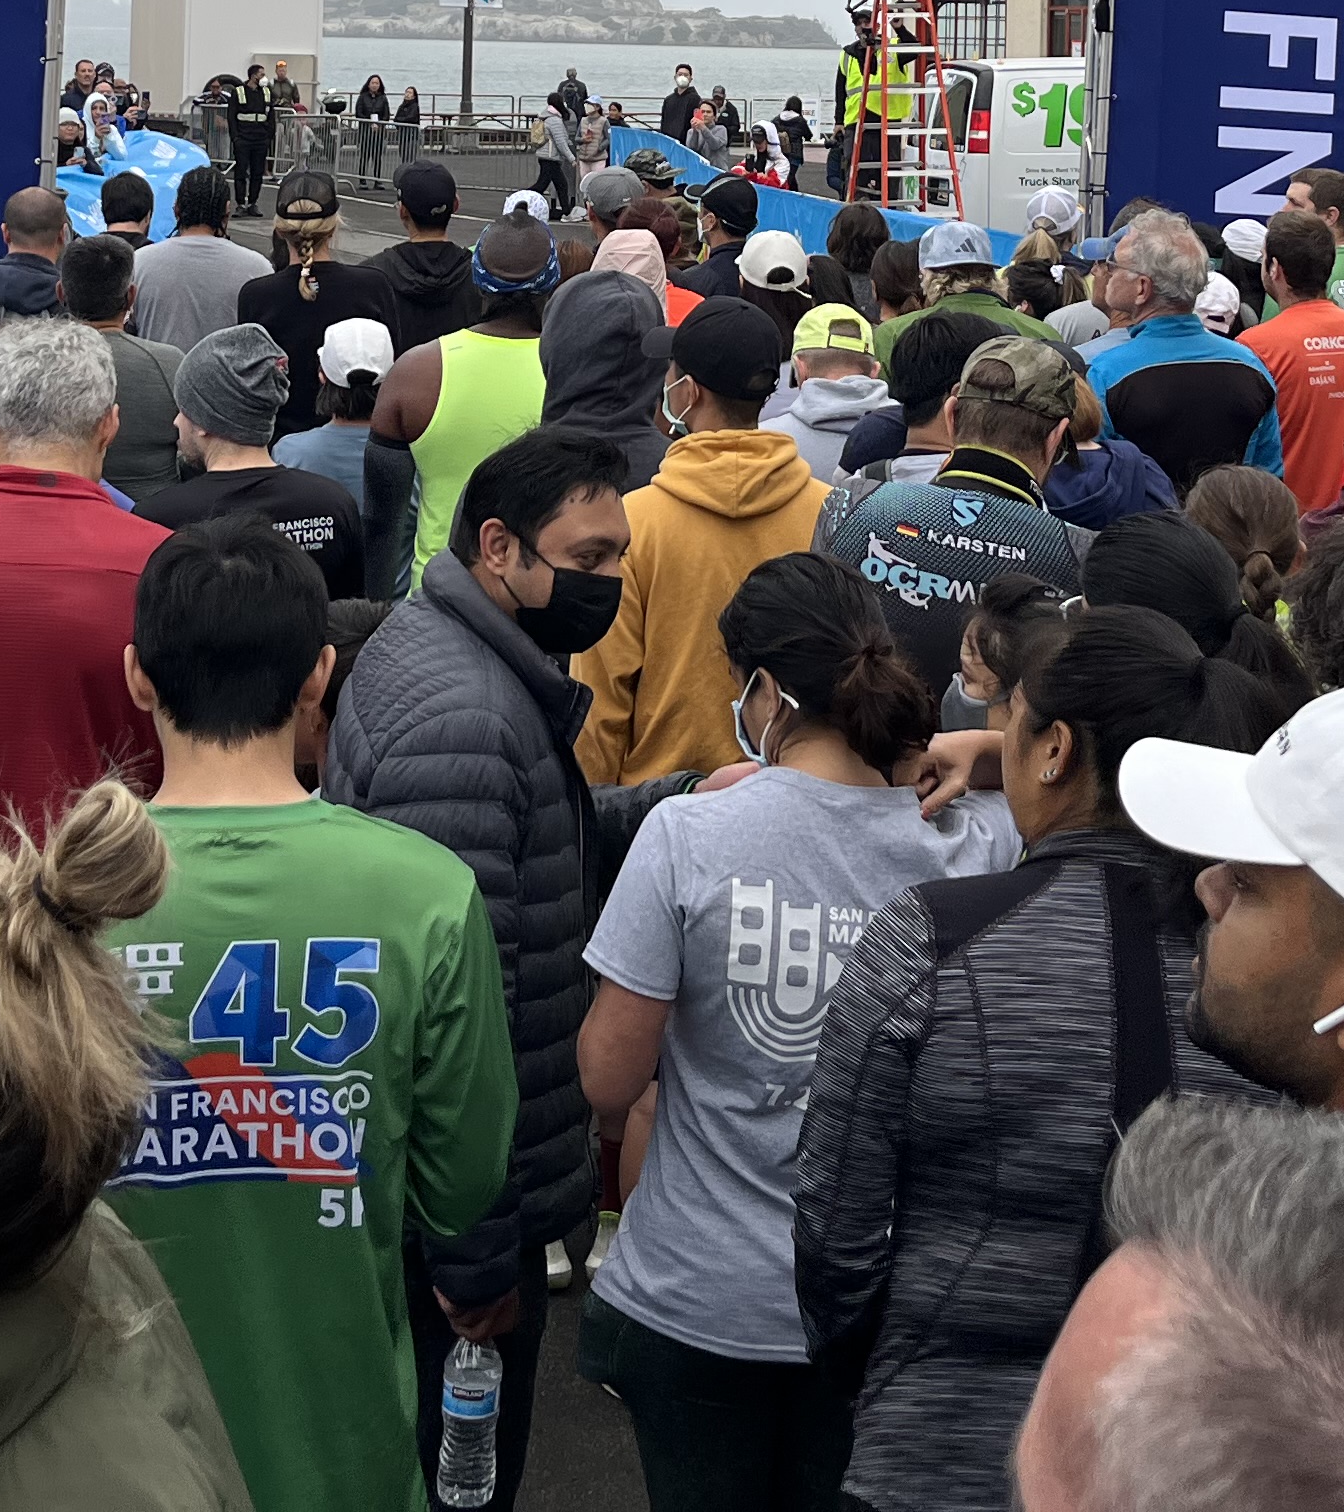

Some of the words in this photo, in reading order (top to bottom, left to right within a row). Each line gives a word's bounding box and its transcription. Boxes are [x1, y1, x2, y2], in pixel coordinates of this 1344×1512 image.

[1018, 176, 1049, 186] Truck
[272, 516, 334, 532] FRANCISCO
[927, 529, 1027, 561] KARSTEN
[828, 906, 863, 923] SAN
[189, 937, 381, 1068] 45
[170, 1082, 371, 1121] FRANCISCO
[120, 1117, 367, 1167] ARATHO
